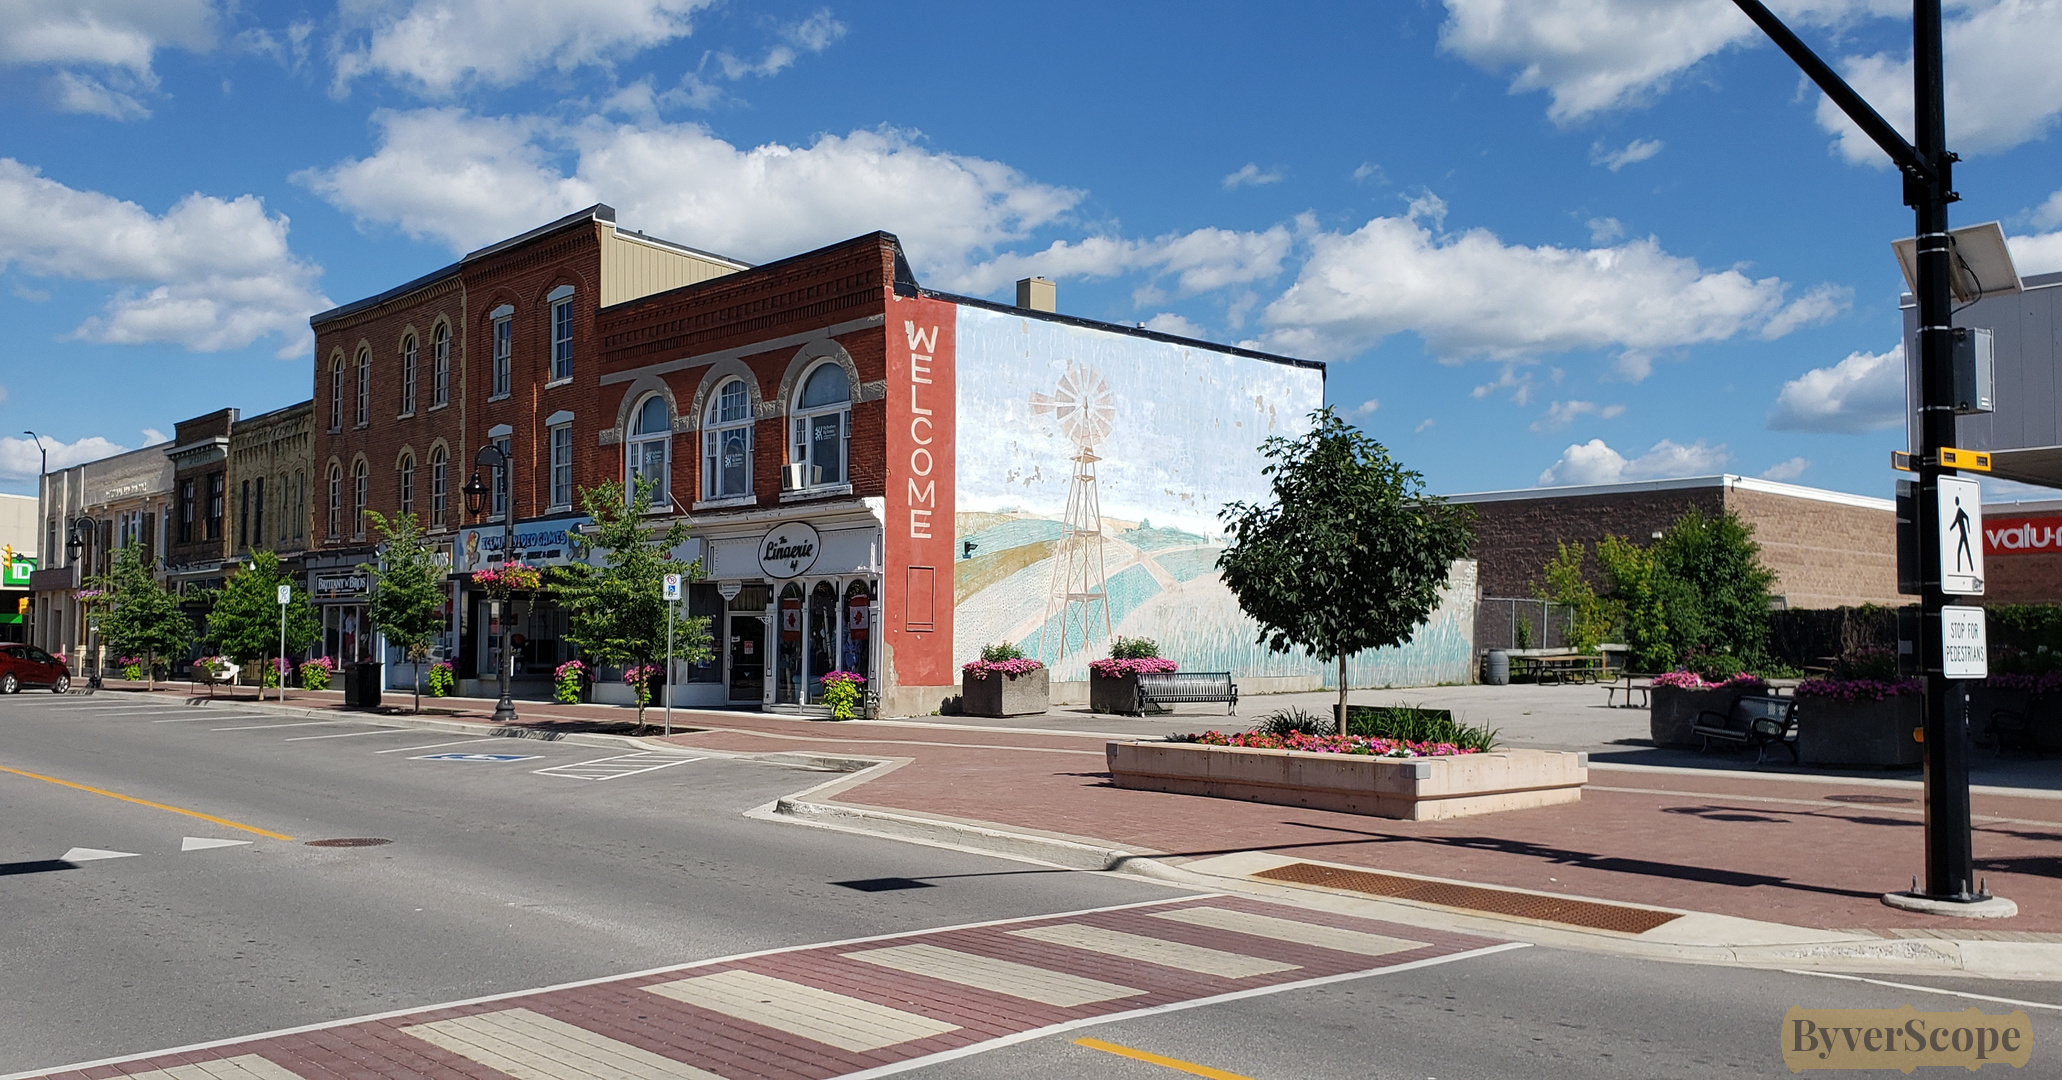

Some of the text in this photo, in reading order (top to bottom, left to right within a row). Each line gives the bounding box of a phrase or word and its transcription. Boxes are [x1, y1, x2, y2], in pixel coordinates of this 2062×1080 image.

[904, 320, 939, 539] WELCOME
[513, 533, 537, 549] VIDEO
[538, 529, 568, 547] GAMES
[1985, 522, 2062, 550] valu-
[763, 539, 814, 562] Lingerie
[12, 563, 33, 579] TD
[1950, 622, 1979, 639] STOP FOR
[1946, 645, 1984, 662] PEDESTRIANS
